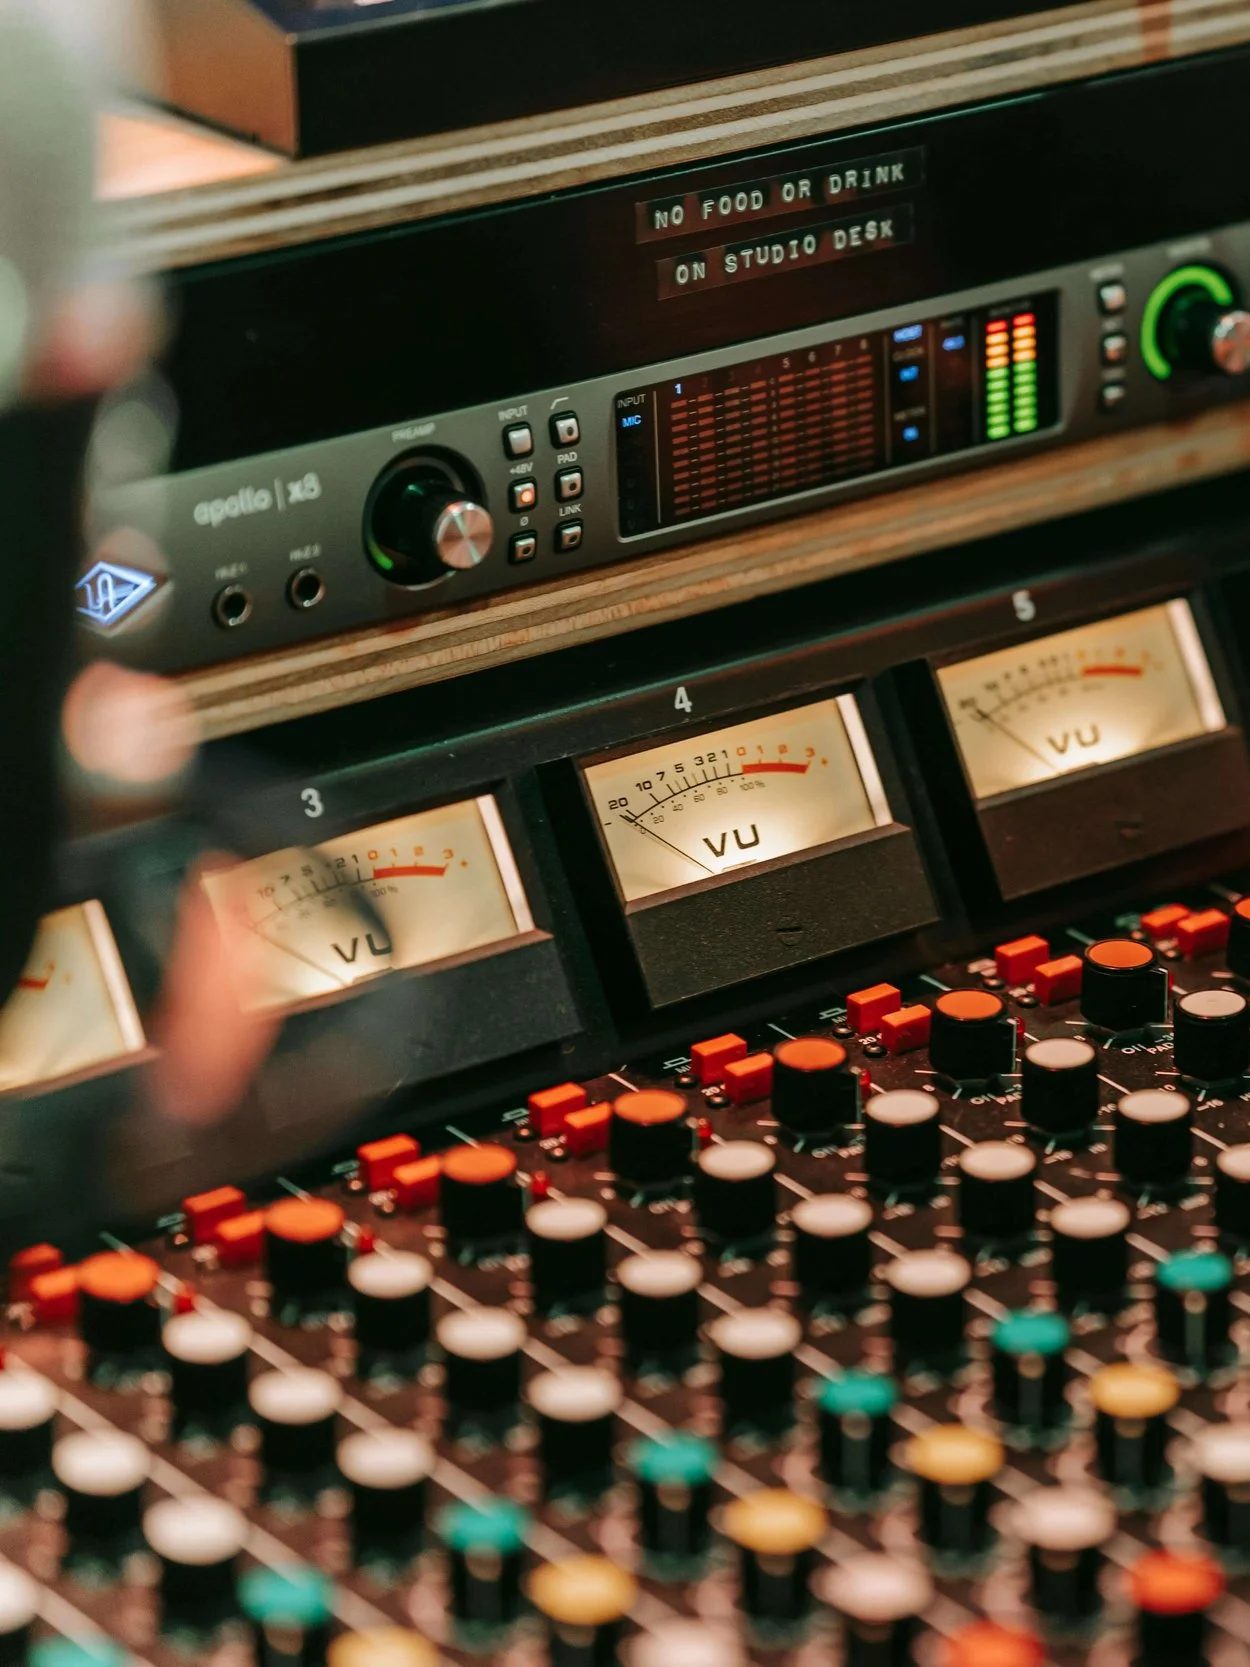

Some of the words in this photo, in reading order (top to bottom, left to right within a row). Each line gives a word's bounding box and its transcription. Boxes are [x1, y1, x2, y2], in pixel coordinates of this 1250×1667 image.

[655, 205, 684, 229] NO
[703, 190, 763, 220] FOOD
[782, 179, 811, 202] OR
[829, 163, 904, 195] DRINK
[676, 261, 705, 285] ON
[725, 235, 816, 274] STUDIO
[834, 219, 893, 250] DESK
[674, 383, 682, 395] 1
[617, 393, 646, 409] INPUT
[498, 405, 528, 421] INPUT
[622, 414, 642, 428] MIC
[509, 462, 533, 475] +48V
[556, 451, 578, 464] PAD
[193, 485, 273, 528] apollo
[559, 504, 582, 517] LINK
[1012, 590, 1035, 622] 5
[674, 686, 693, 713] 4
[1047, 723, 1100, 754] VU
[608, 797, 629, 811] 20
[635, 780, 653, 792] 10
[656, 771, 666, 781] 7
[674, 763, 685, 773] 5
[694, 755, 705, 766] 3
[707, 752, 717, 763] 2
[722, 750, 729, 759] 1
[736, 747, 746, 756] 0
[805, 747, 815, 758] 3
[301, 788, 324, 818] 3
[653, 815, 664, 824] 20
[672, 804, 684, 812] 40
[702, 824, 760, 858] VU
[367, 850, 378, 861] 0
[443, 849, 454, 860] 3
